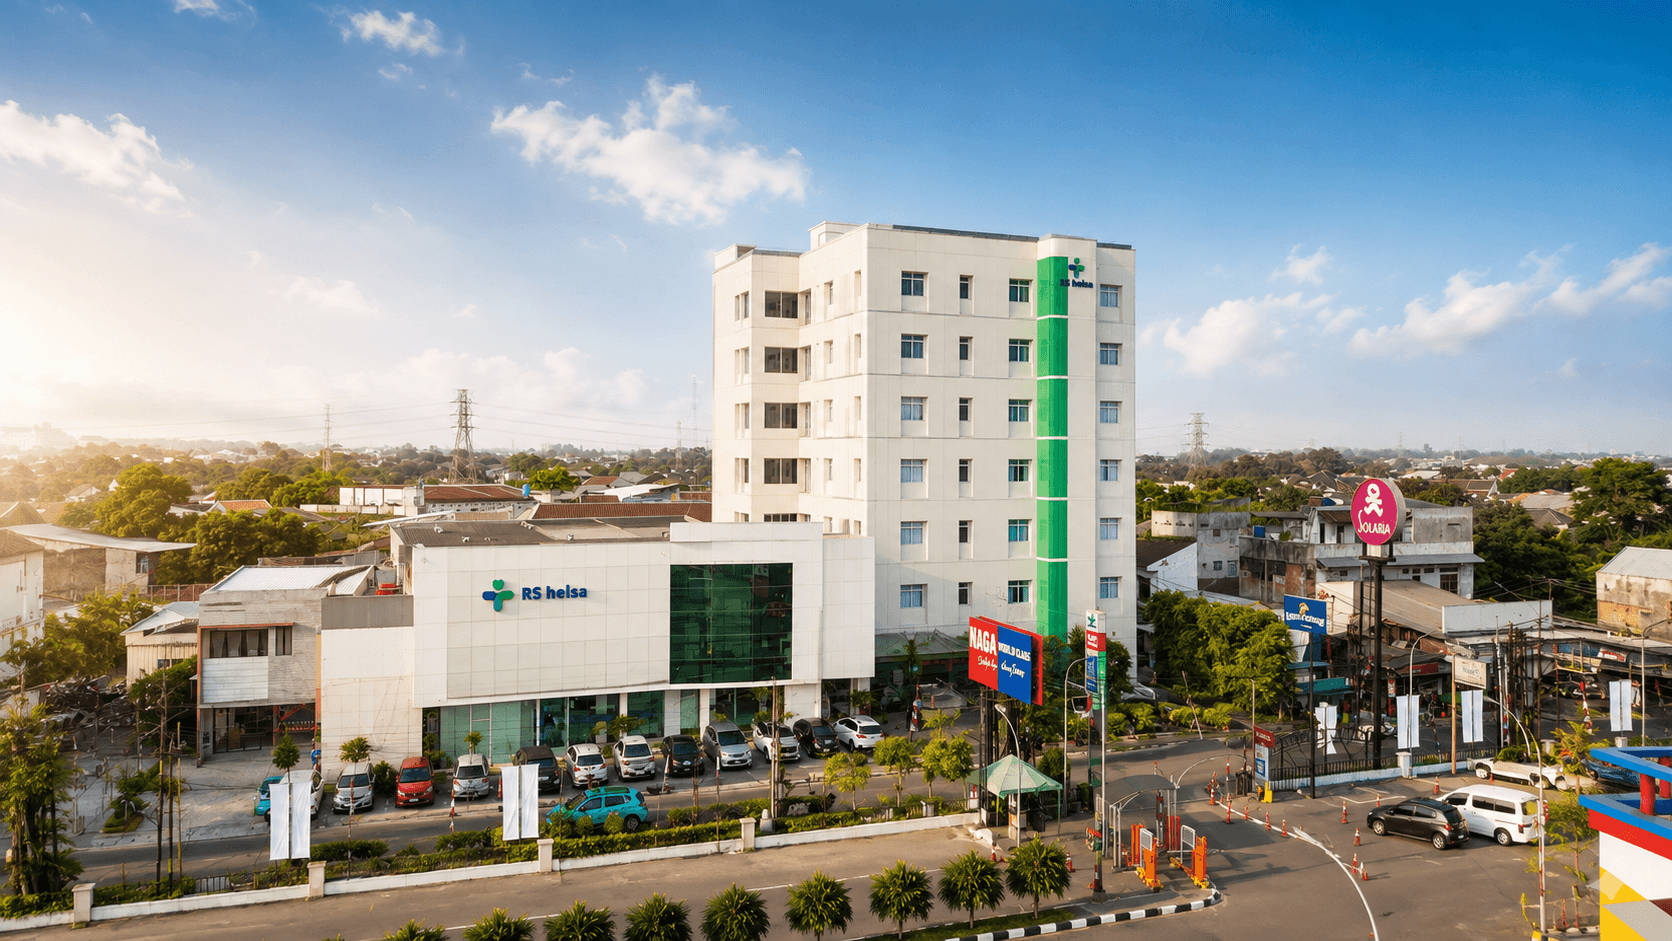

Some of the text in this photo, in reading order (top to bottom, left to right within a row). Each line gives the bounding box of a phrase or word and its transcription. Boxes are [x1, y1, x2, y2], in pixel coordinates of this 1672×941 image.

[522, 584, 587, 600] RS helsa
[969, 625, 998, 656] NAGA
